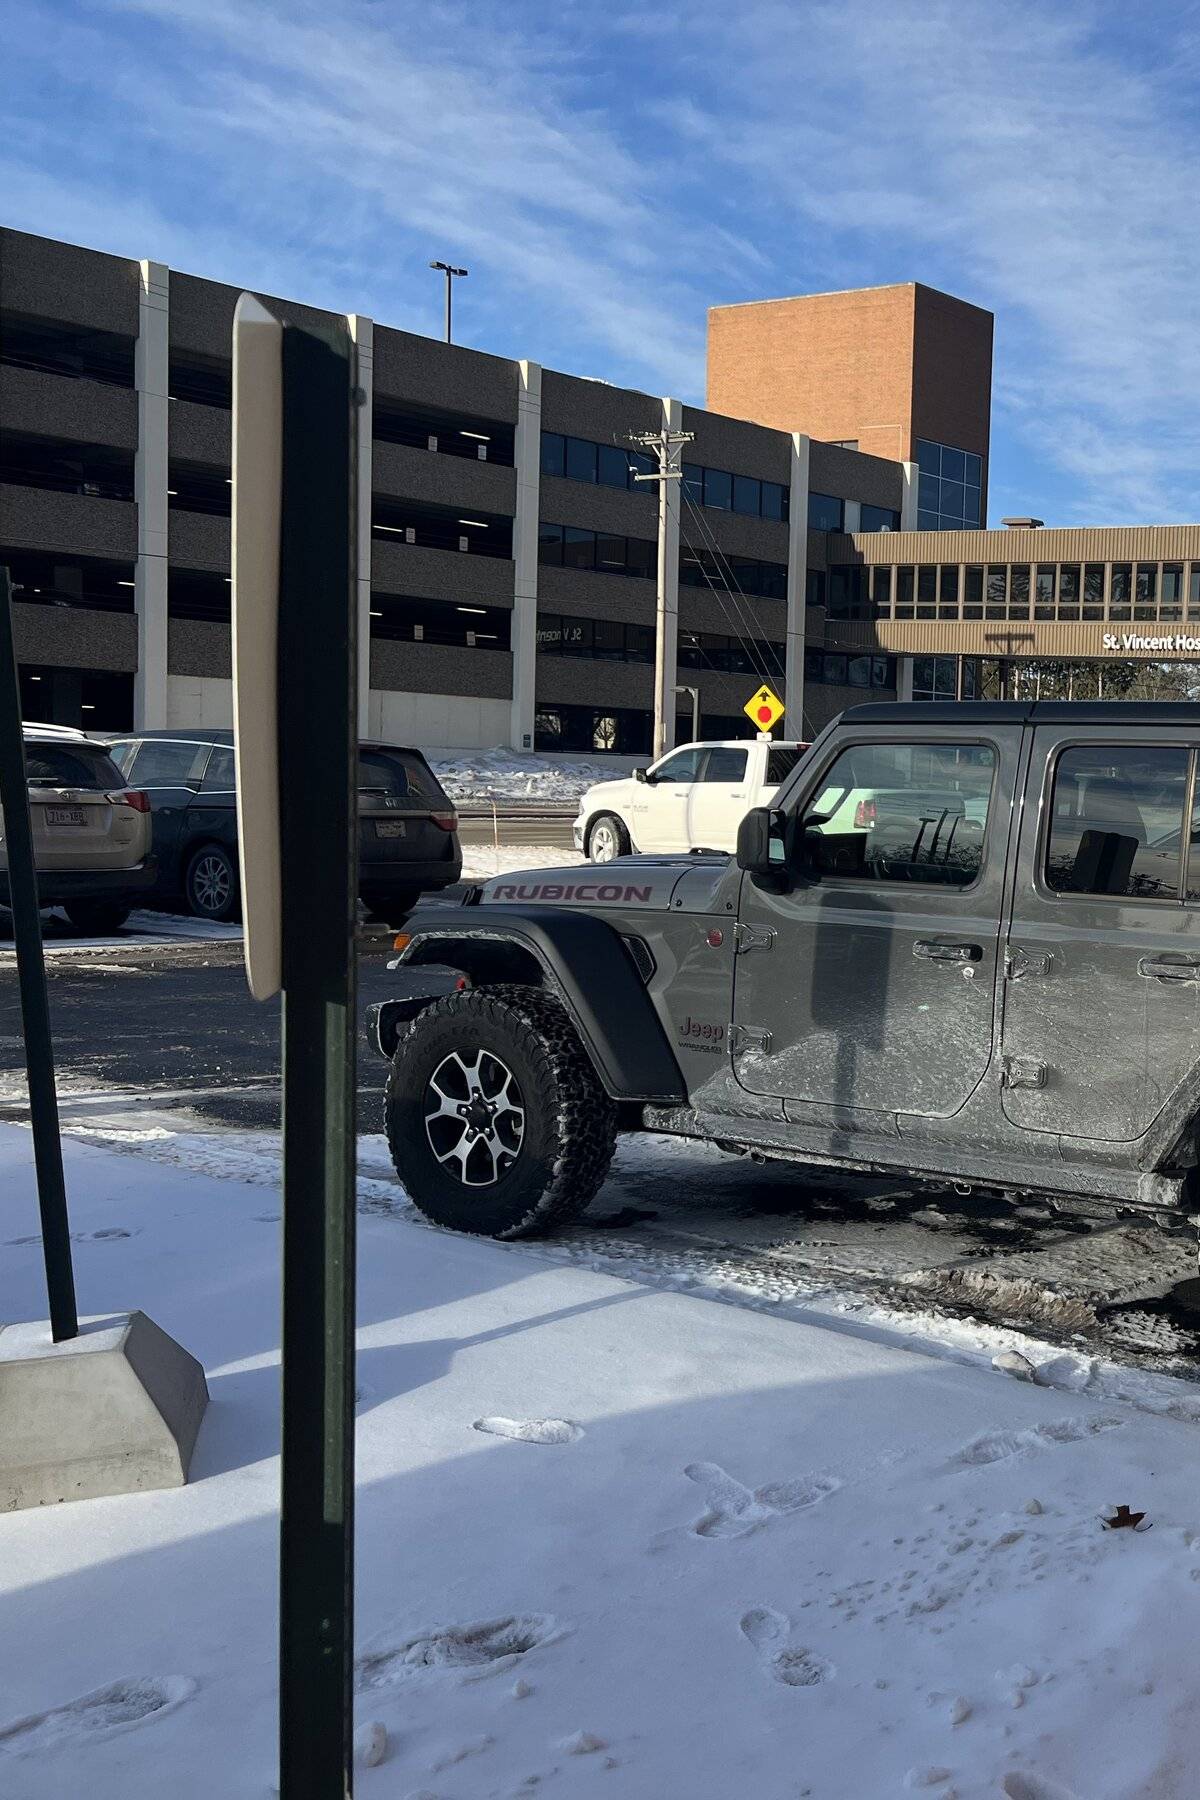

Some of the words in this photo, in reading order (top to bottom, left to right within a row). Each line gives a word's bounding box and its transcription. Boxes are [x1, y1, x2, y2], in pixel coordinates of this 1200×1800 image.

[1102, 633, 1120, 649] St.
[1121, 633, 1174, 650] Vincent
[493, 885, 652, 902] RUBICON
[679, 1016, 723, 1043] Jeep
